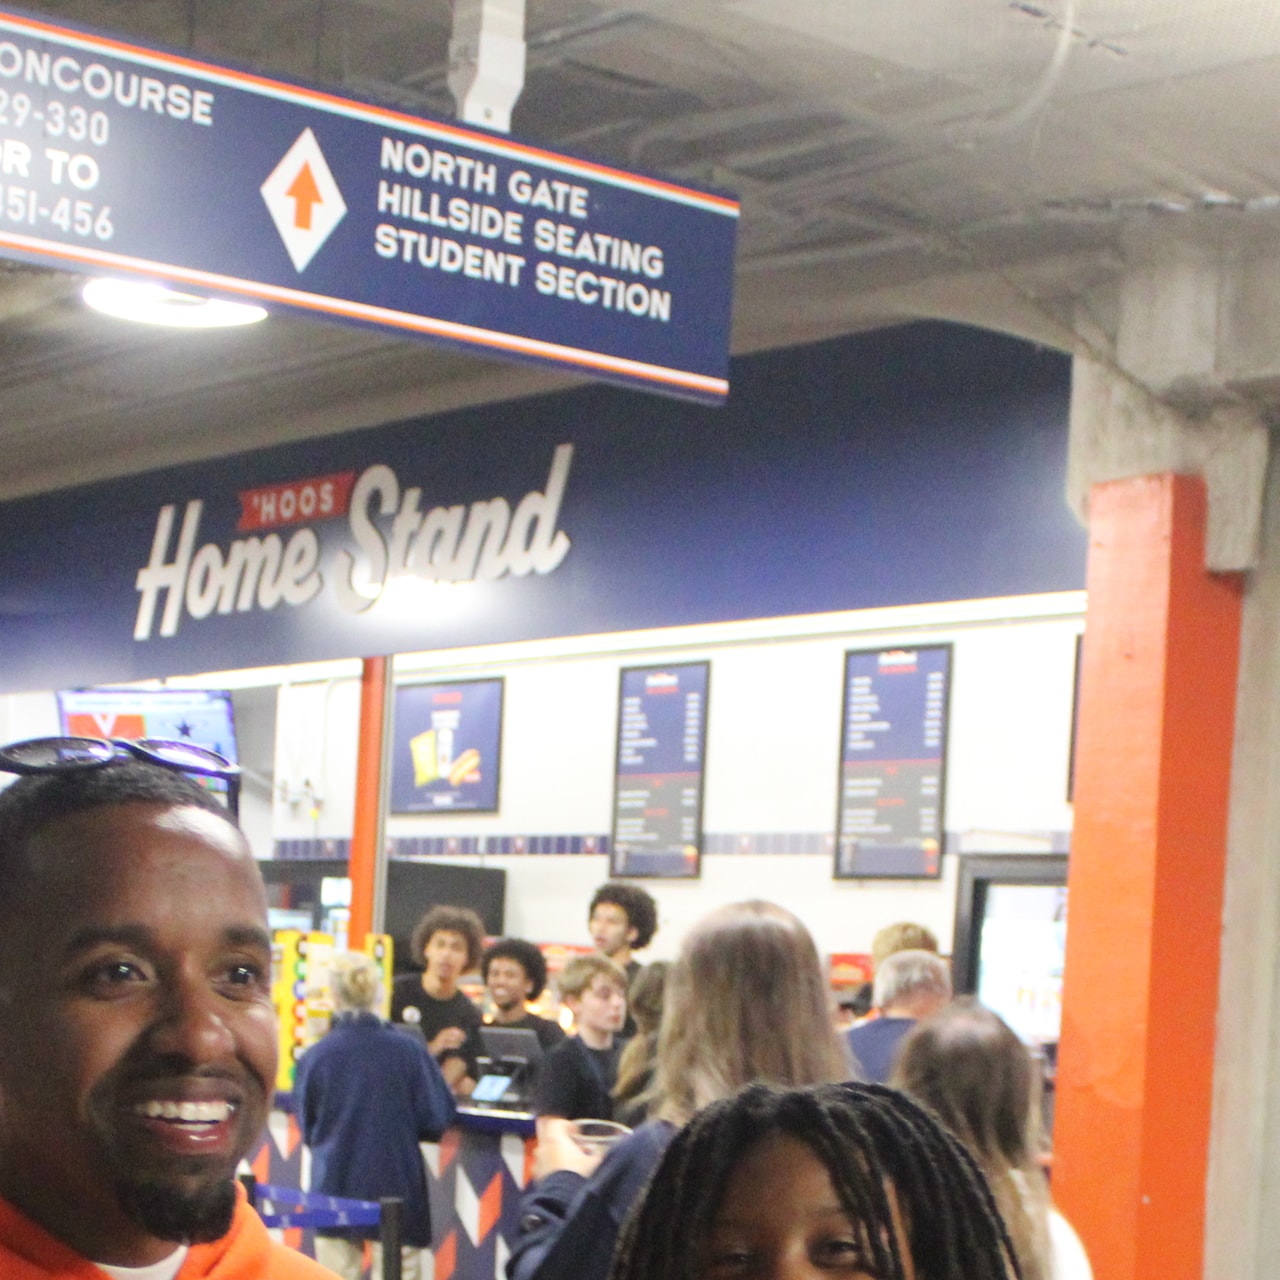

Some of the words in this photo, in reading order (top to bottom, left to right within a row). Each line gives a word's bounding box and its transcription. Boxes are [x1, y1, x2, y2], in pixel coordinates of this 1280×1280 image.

[46, 148, 99, 190] TO
[380, 137, 497, 195] NORTH
[508, 171, 588, 219] GATE
[375, 223, 526, 287] STUDENT
[535, 261, 671, 321] SECTION
[377, 180, 524, 244] HILLSIDE
[534, 218, 664, 279] SEATING
[133, 499, 324, 640] Home
[341, 443, 574, 613] Stand
